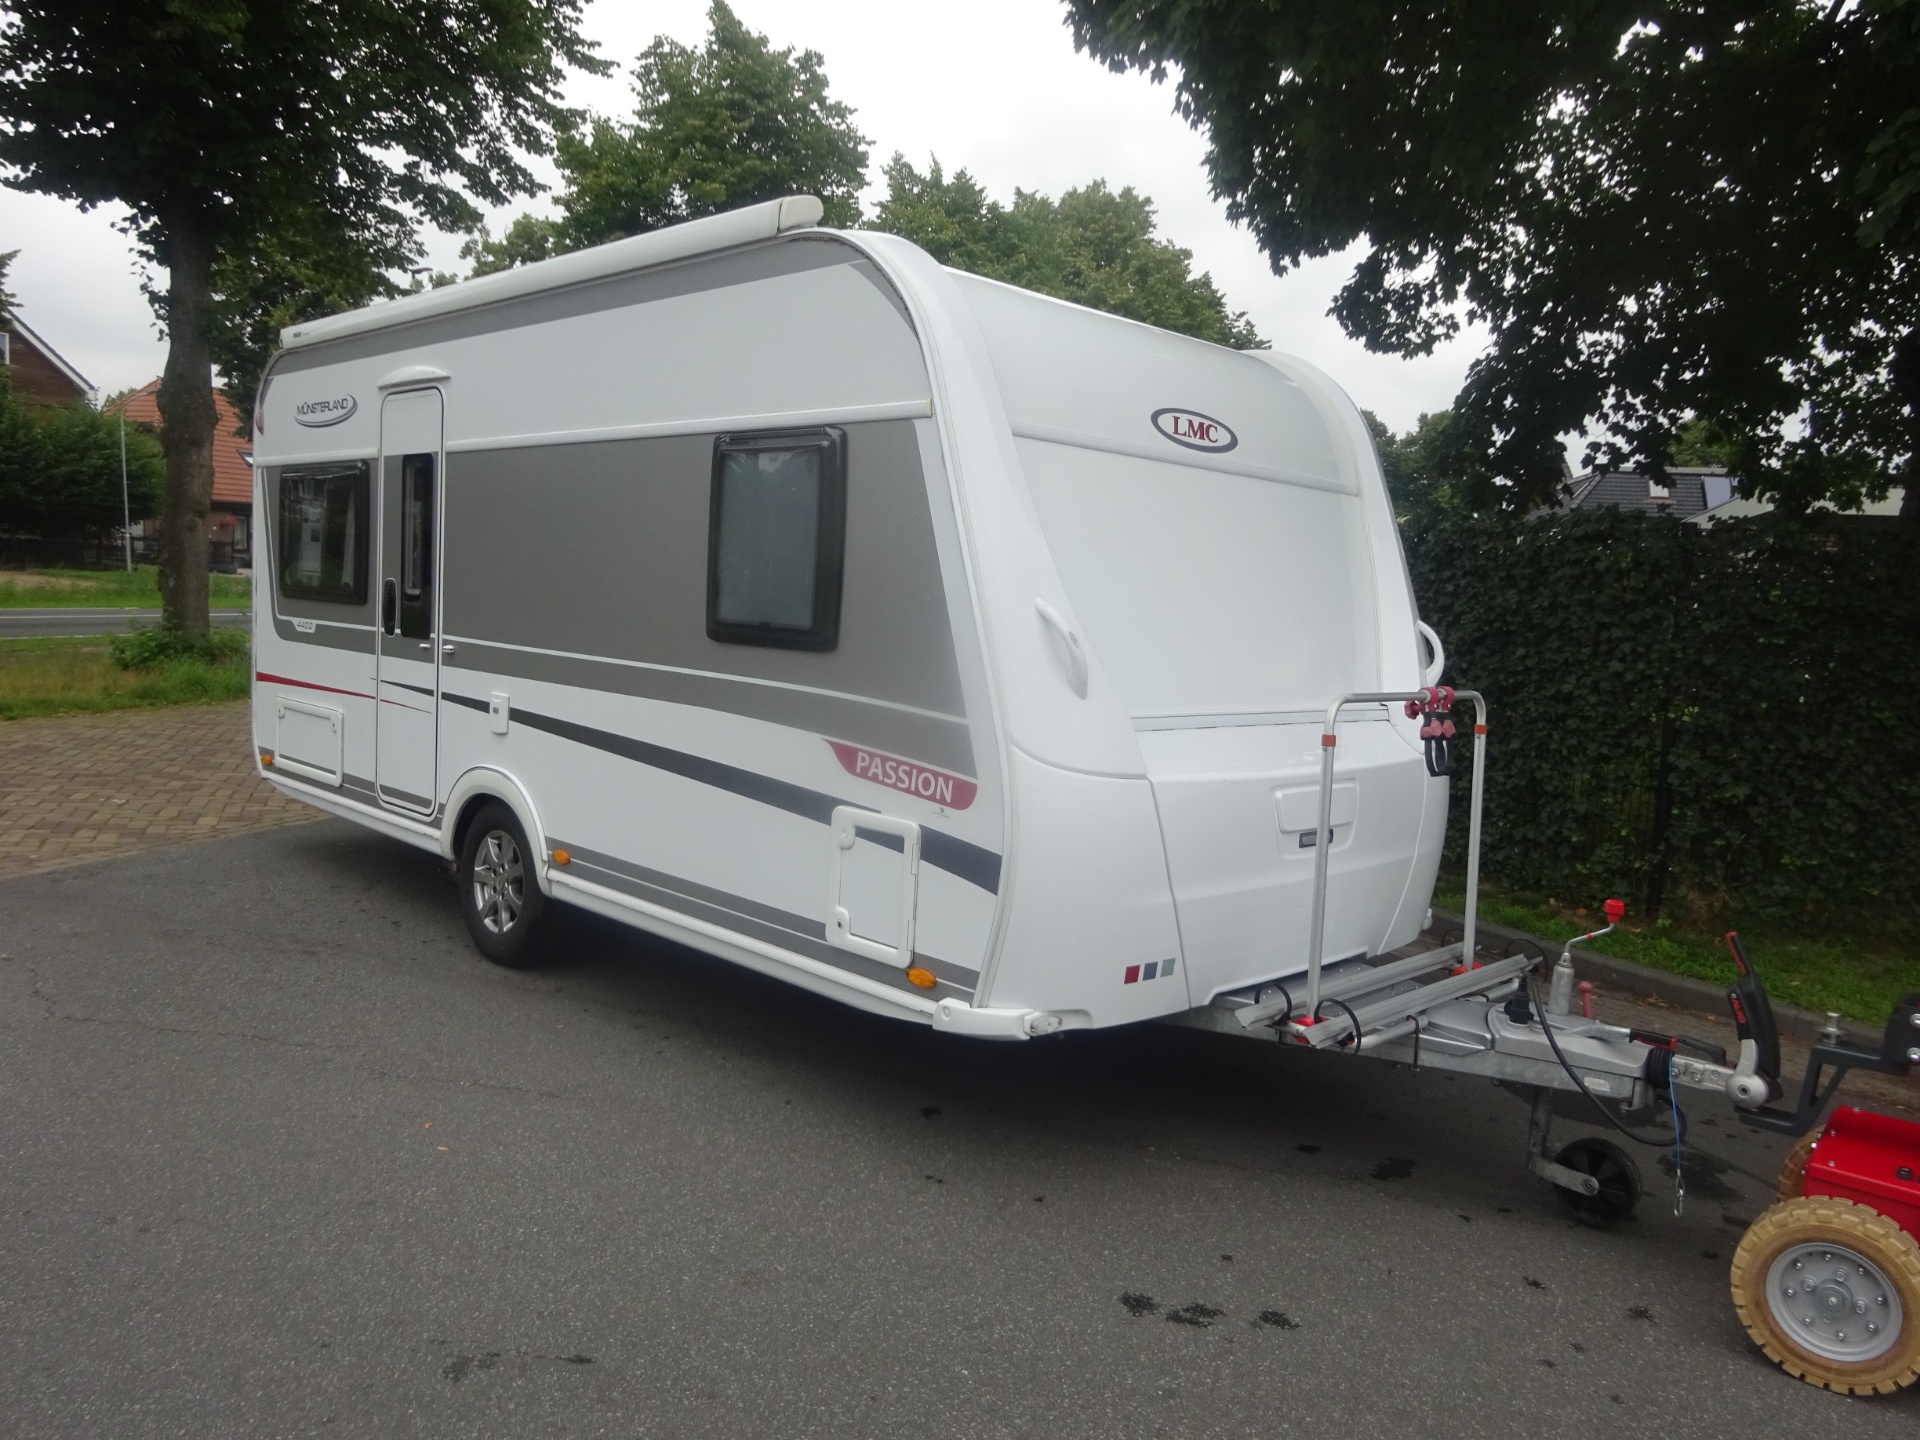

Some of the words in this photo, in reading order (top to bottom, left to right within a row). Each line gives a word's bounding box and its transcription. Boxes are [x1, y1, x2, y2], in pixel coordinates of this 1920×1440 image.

[296, 398, 348, 415] MÜNSTERLAND
[1172, 415, 1218, 443] LMC
[856, 751, 954, 803] PASSION
